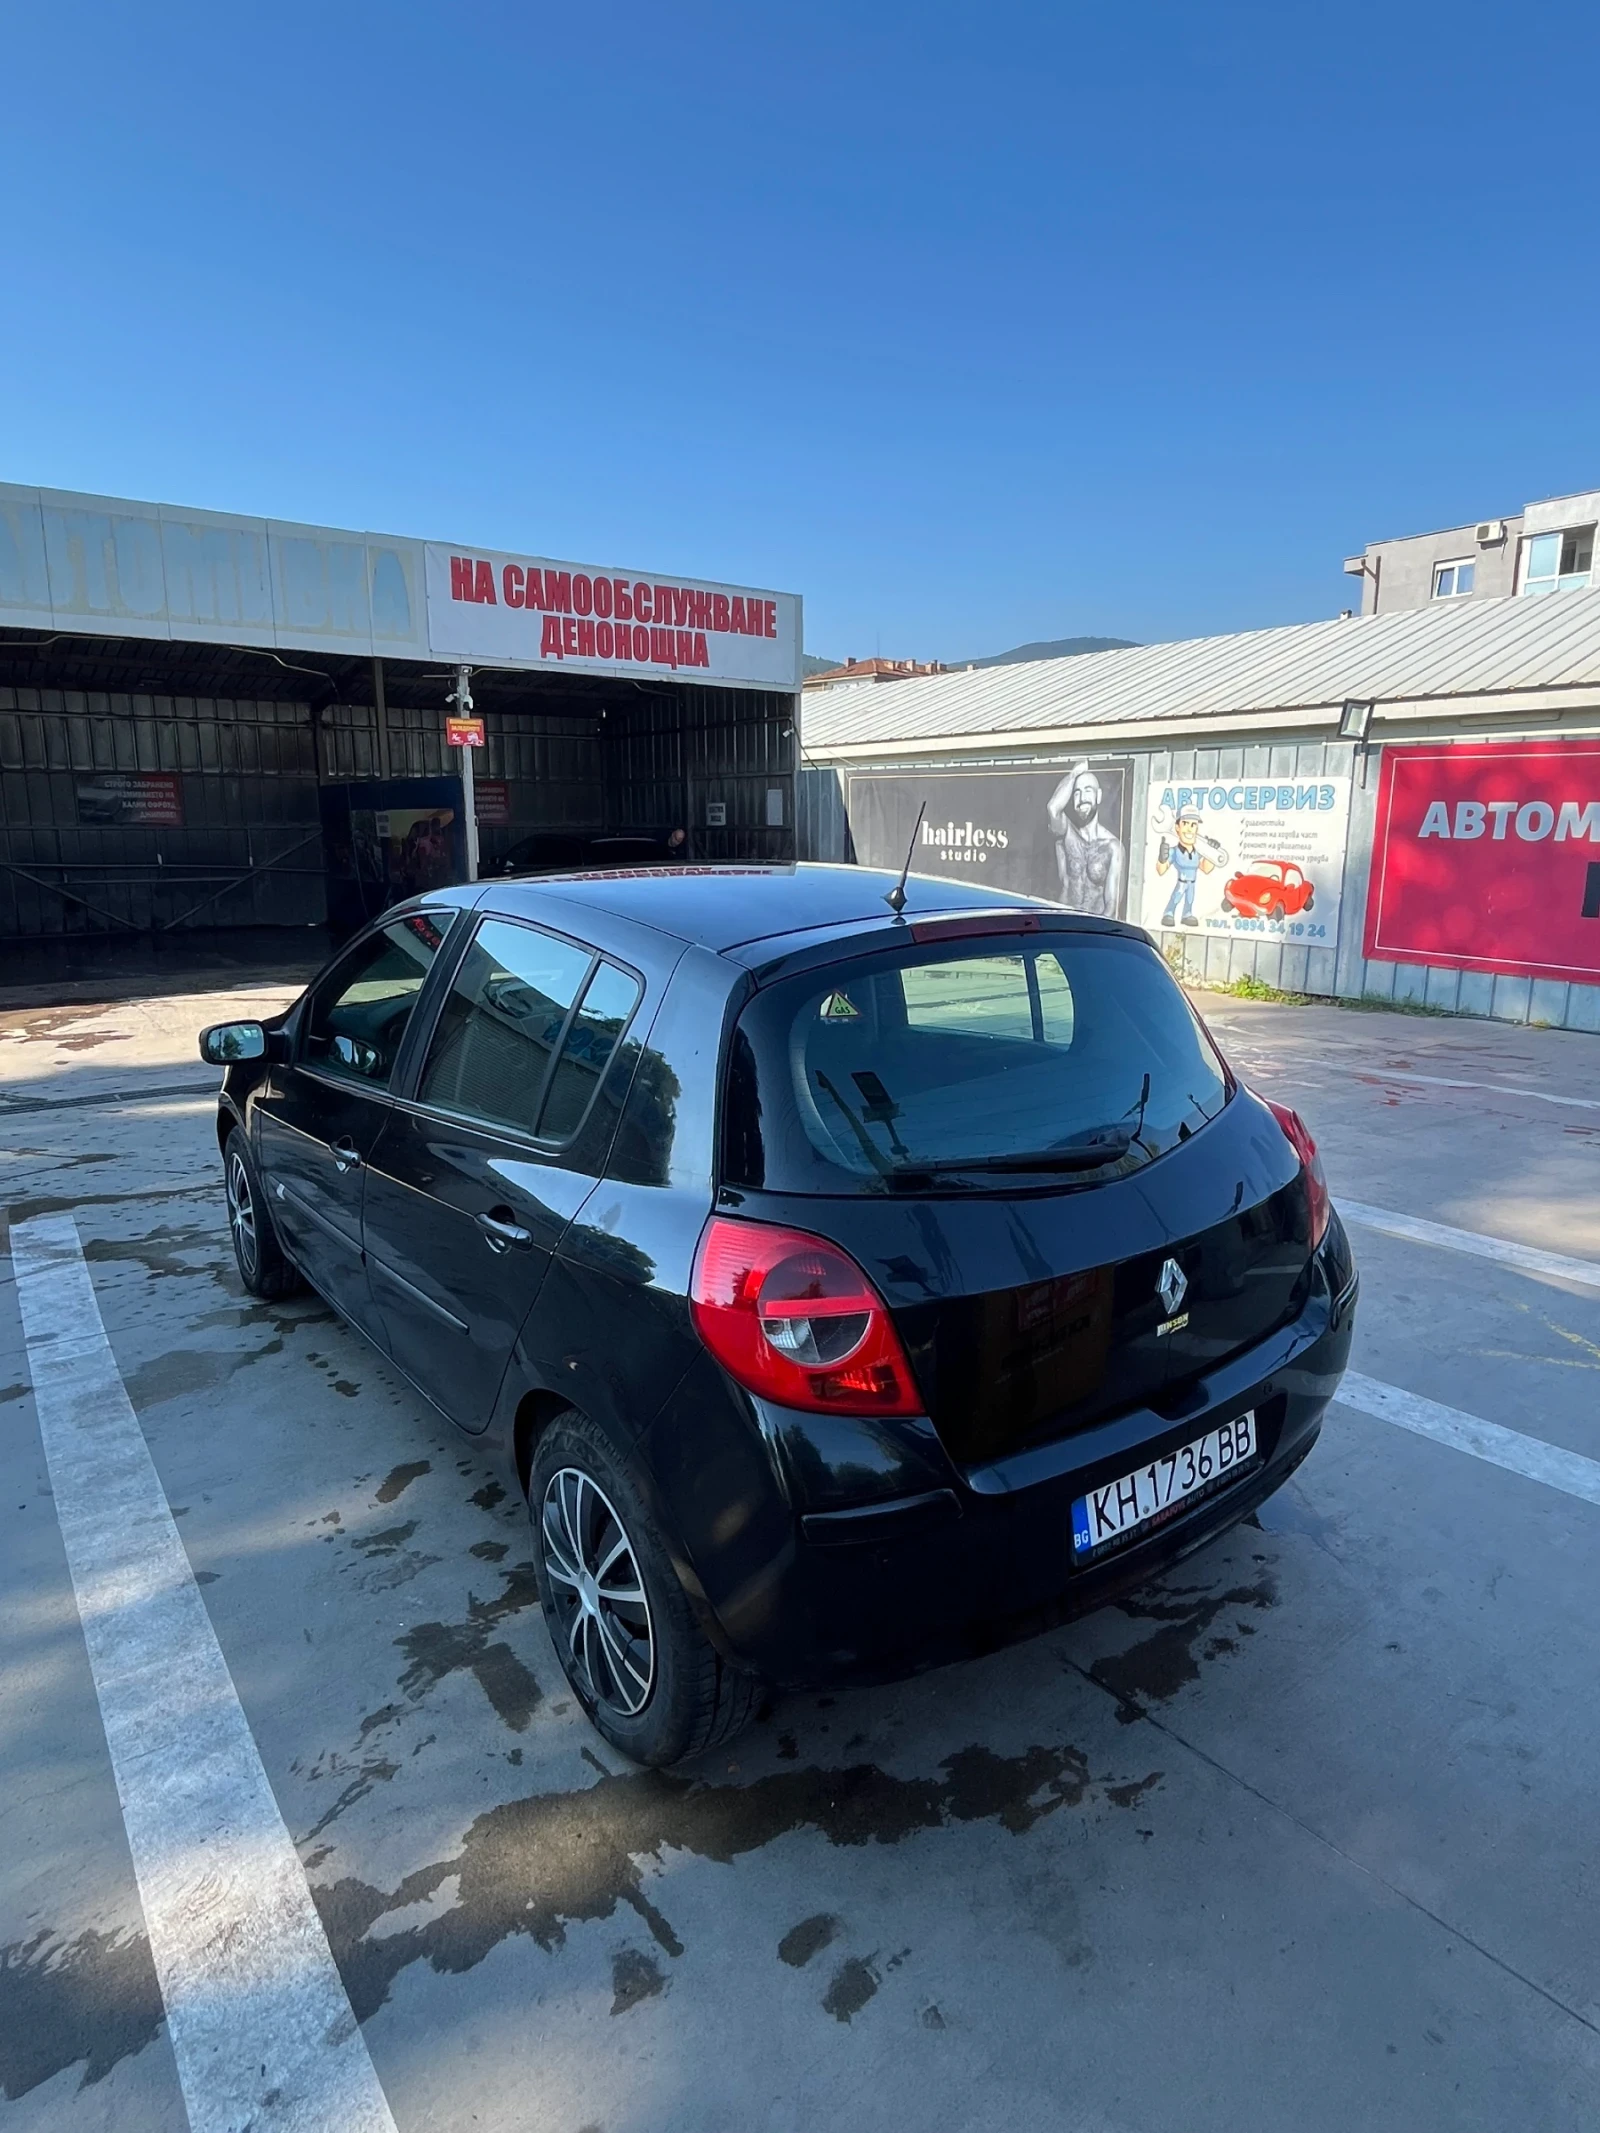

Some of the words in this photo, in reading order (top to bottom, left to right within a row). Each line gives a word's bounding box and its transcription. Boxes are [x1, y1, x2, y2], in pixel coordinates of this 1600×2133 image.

[450, 556, 498, 605] НА
[502, 563, 777, 638] САМООБСЛУЖВАНЕ
[540, 615, 710, 670] ДЕНОНОЩНА
[104, 780, 131, 788] СТРОГО
[132, 781, 174, 789] ЗАБРАНЕНО
[1160, 785, 1336, 811] АВТОСЕРВИЗ
[921, 820, 1009, 849] hairless
[1418, 800, 1600, 842] АВТОМ
[940, 849, 987, 862] studio
[1268, 920, 1285, 934] 34
[1289, 922, 1304, 936] 19
[1307, 924, 1326, 938] 24
[834, 1006, 851, 1014] GAS
[1073, 1529, 1089, 1549] BG
[1218, 1415, 1250, 1470] BB
